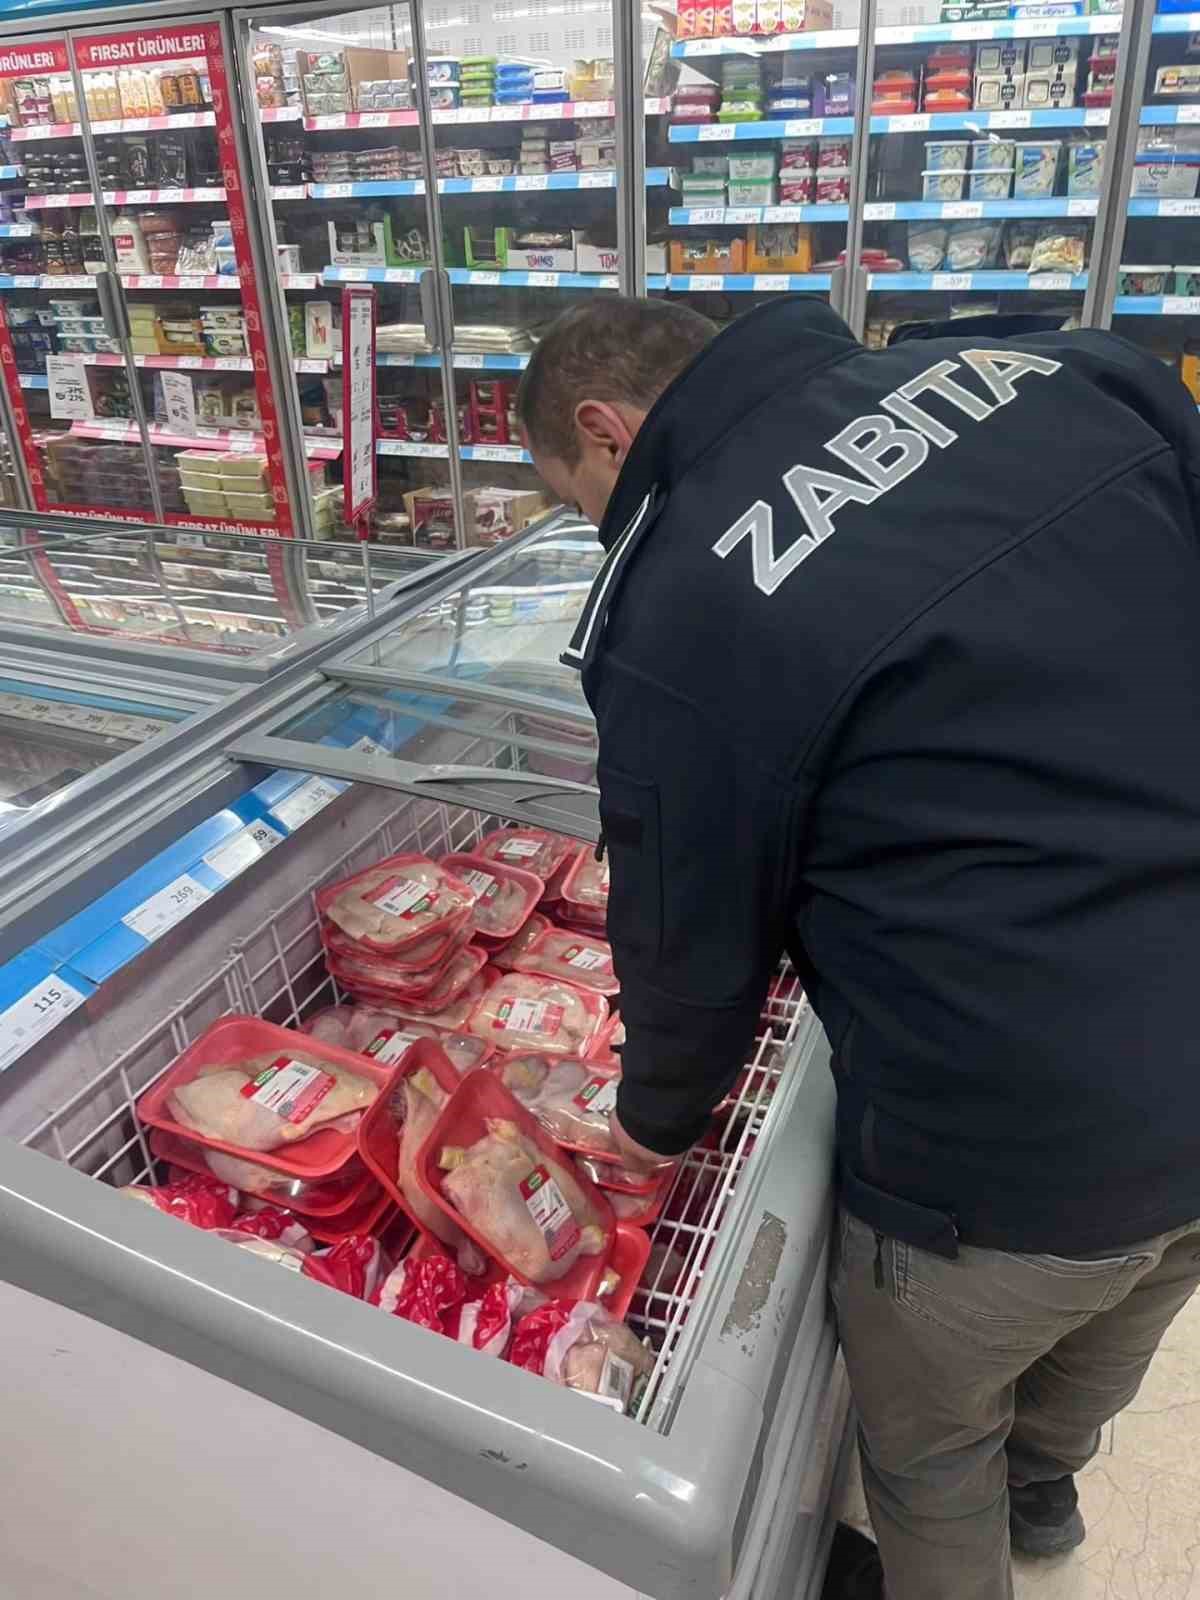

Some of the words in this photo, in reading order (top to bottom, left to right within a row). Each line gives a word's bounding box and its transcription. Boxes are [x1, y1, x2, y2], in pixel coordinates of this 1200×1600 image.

[90, 42, 135, 62] FIRSAT
[138, 34, 206, 57] ÜRÜNLERİ
[711, 348, 1064, 596] ZABITA
[33, 988, 62, 1013] 115
